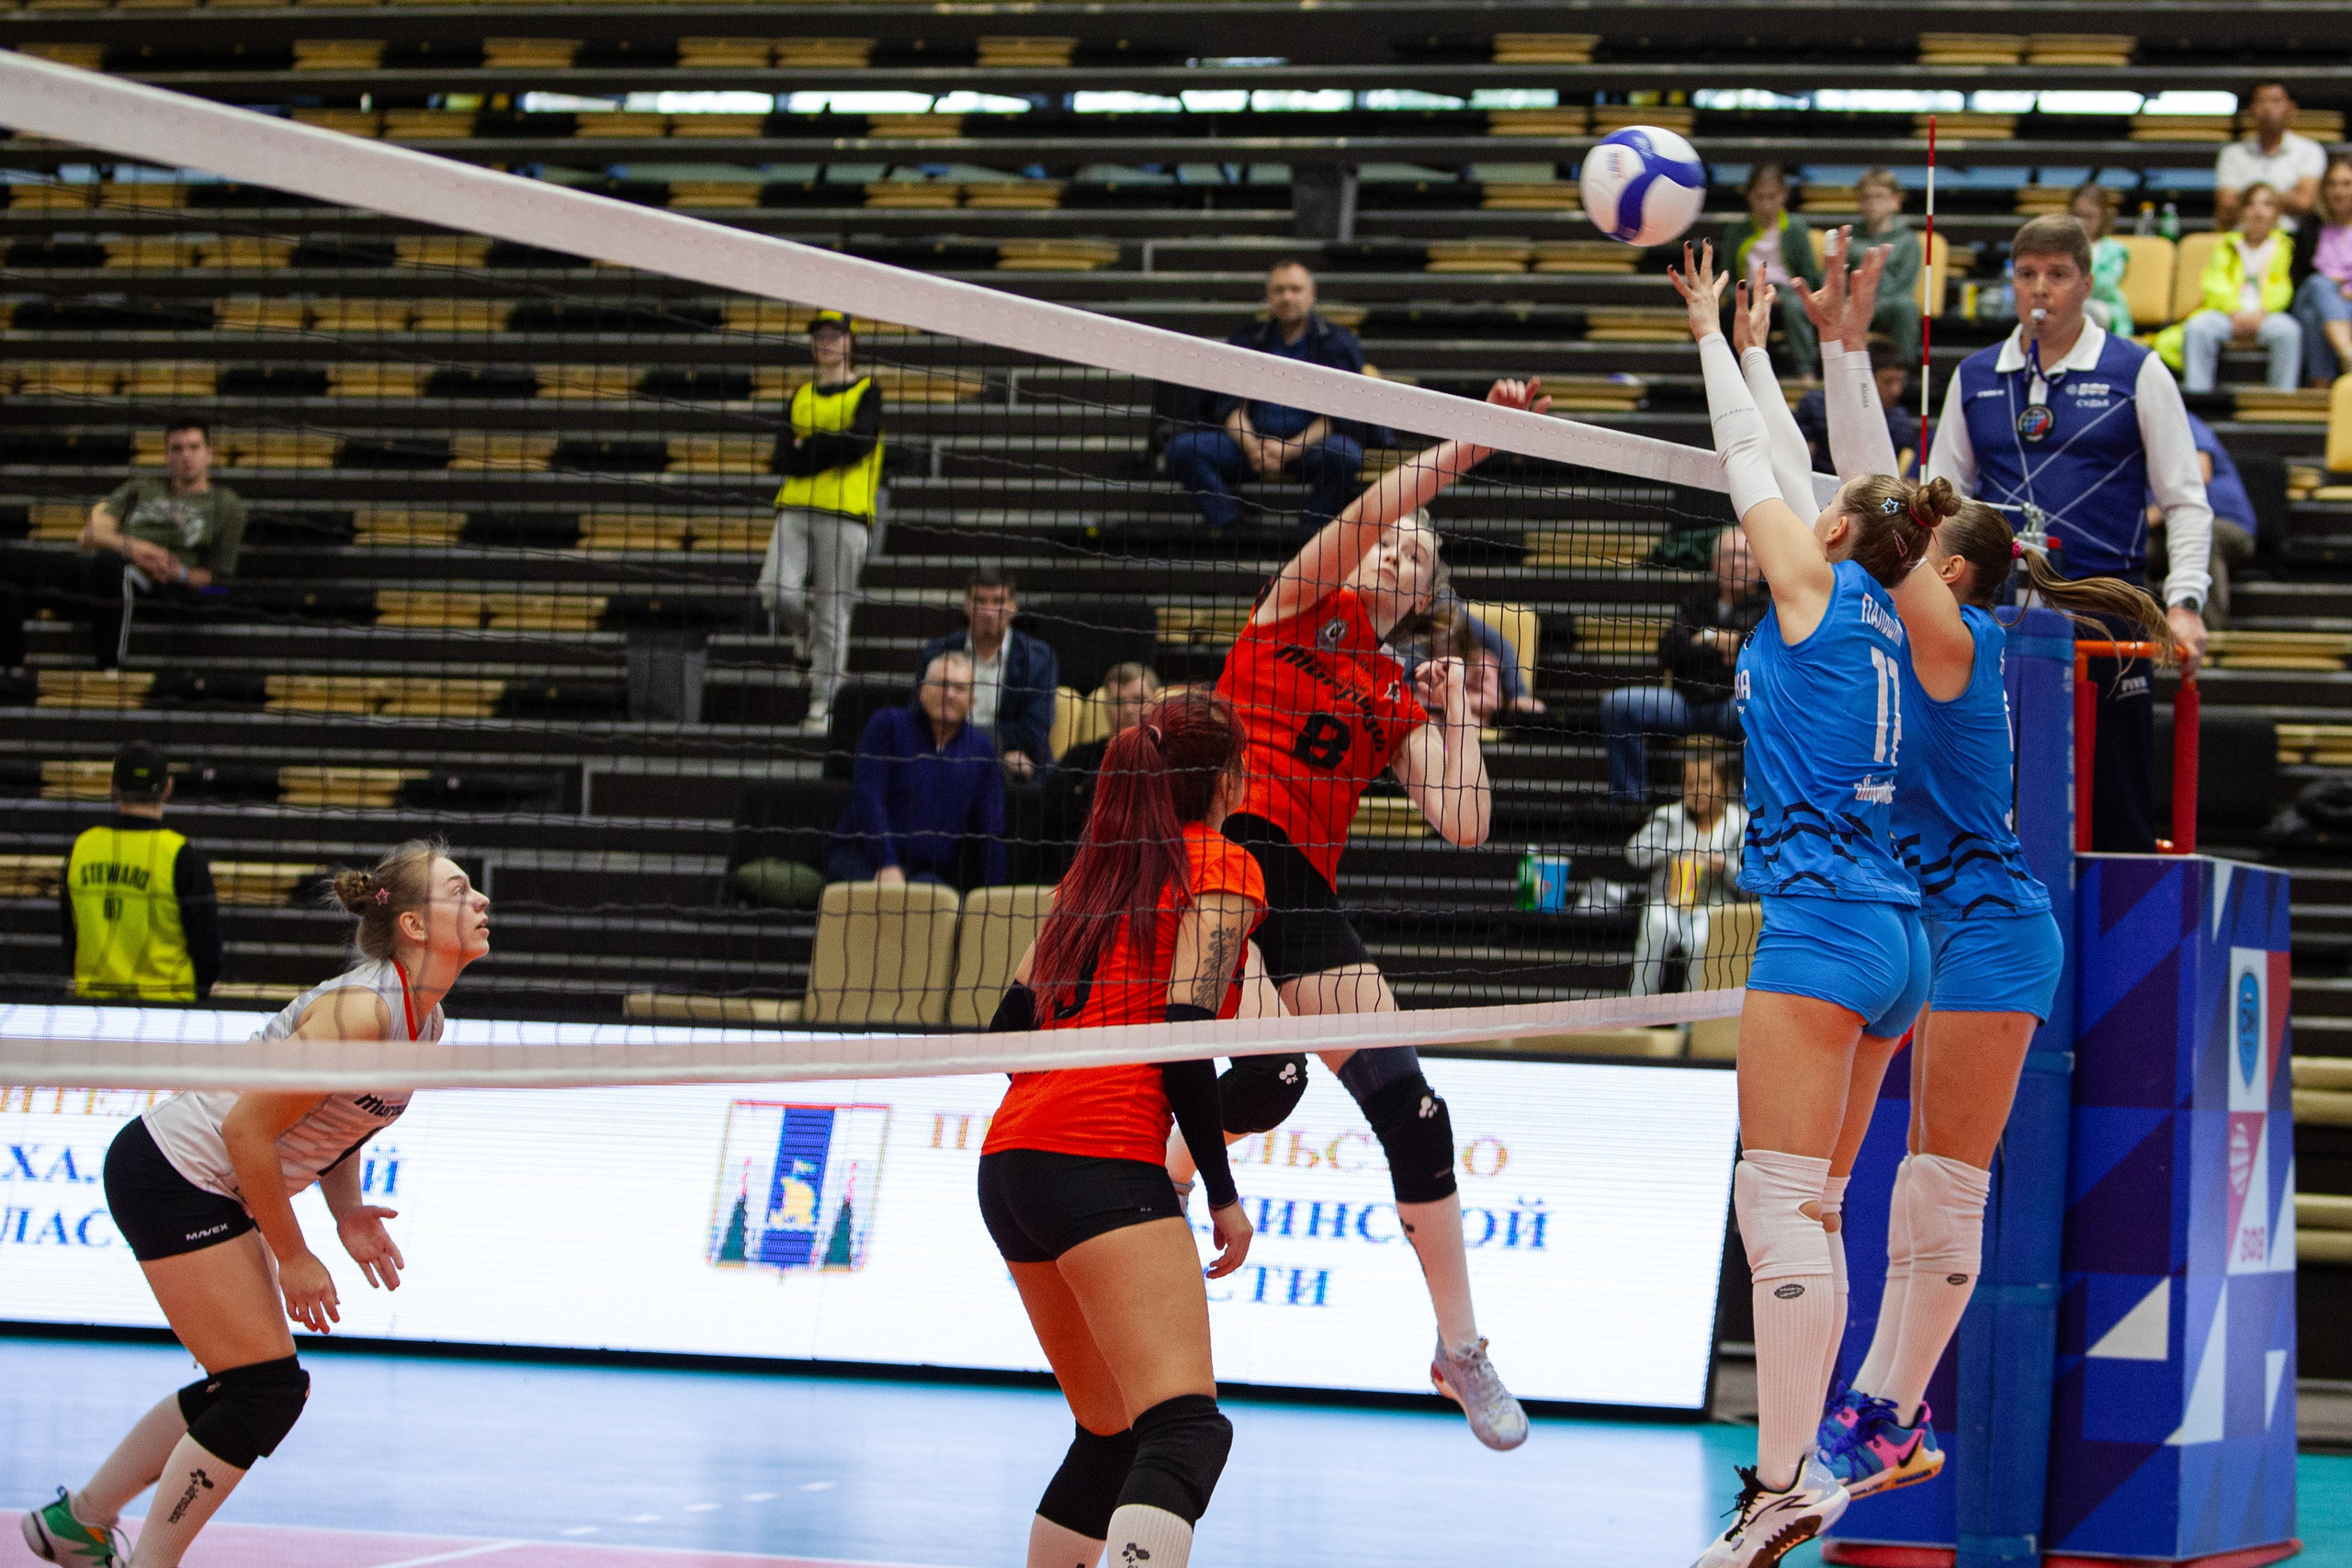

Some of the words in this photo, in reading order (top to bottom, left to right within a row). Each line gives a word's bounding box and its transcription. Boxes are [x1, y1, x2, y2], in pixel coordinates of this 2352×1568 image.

[1294, 711, 1351, 770] 8
[81, 862, 150, 891] STEWARD
[186, 1223, 229, 1241] MAVEX
